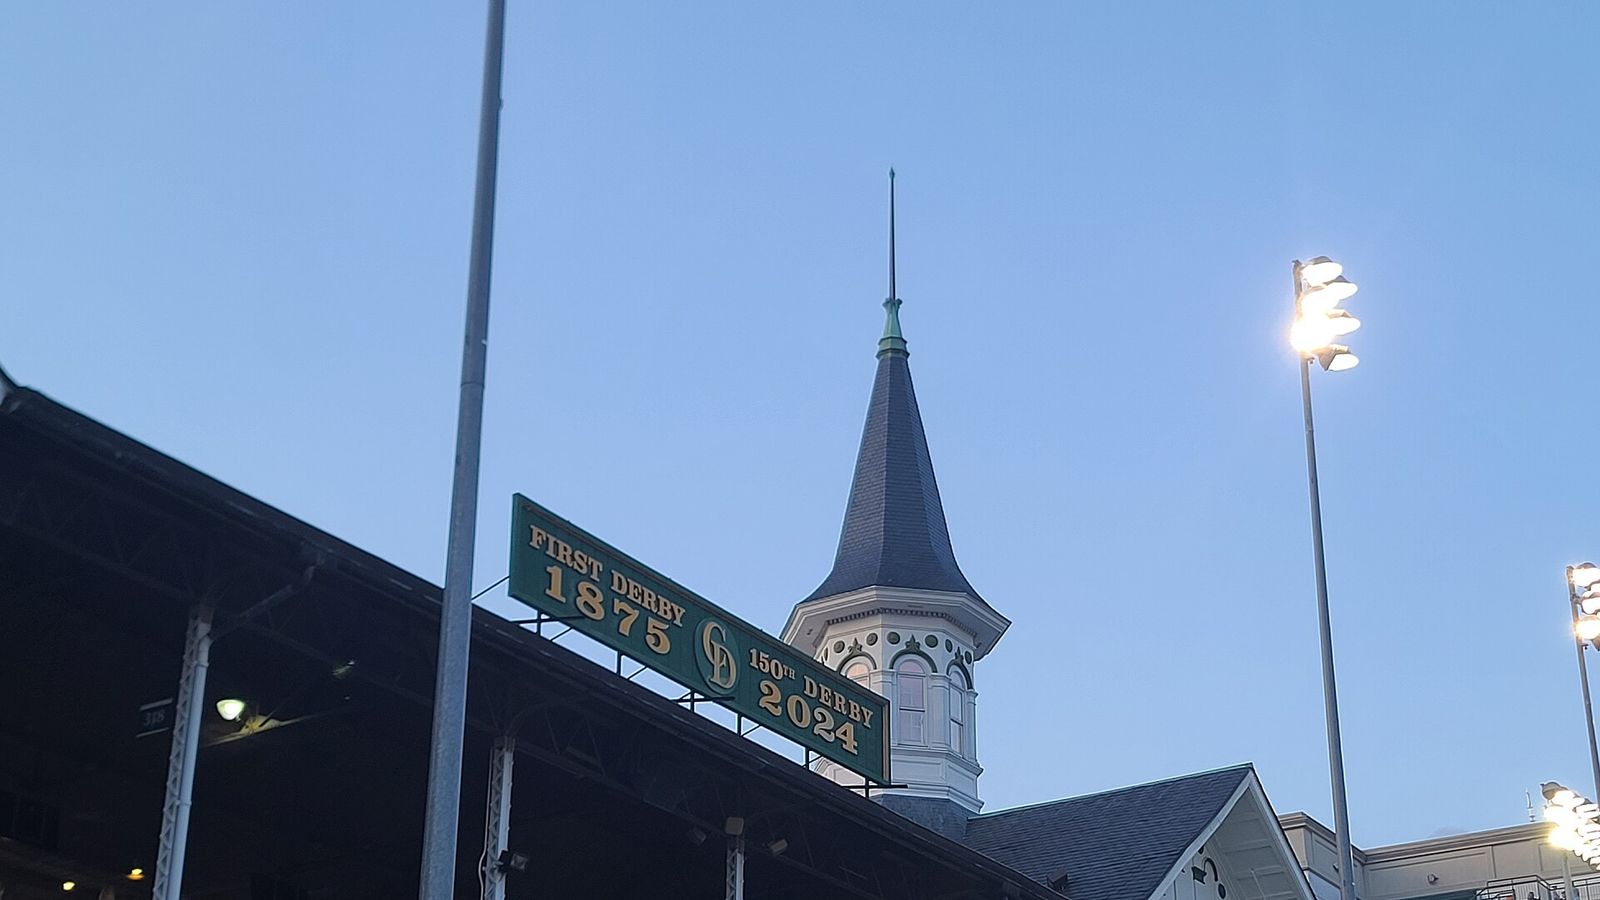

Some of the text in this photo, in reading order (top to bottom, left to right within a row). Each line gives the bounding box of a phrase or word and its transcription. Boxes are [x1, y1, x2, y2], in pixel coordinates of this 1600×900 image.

[529, 525, 686, 627] FIRST DERBY
[545, 565, 671, 655] 1875
[758, 680, 858, 755] 2024
[803, 675, 874, 729] DERBY
